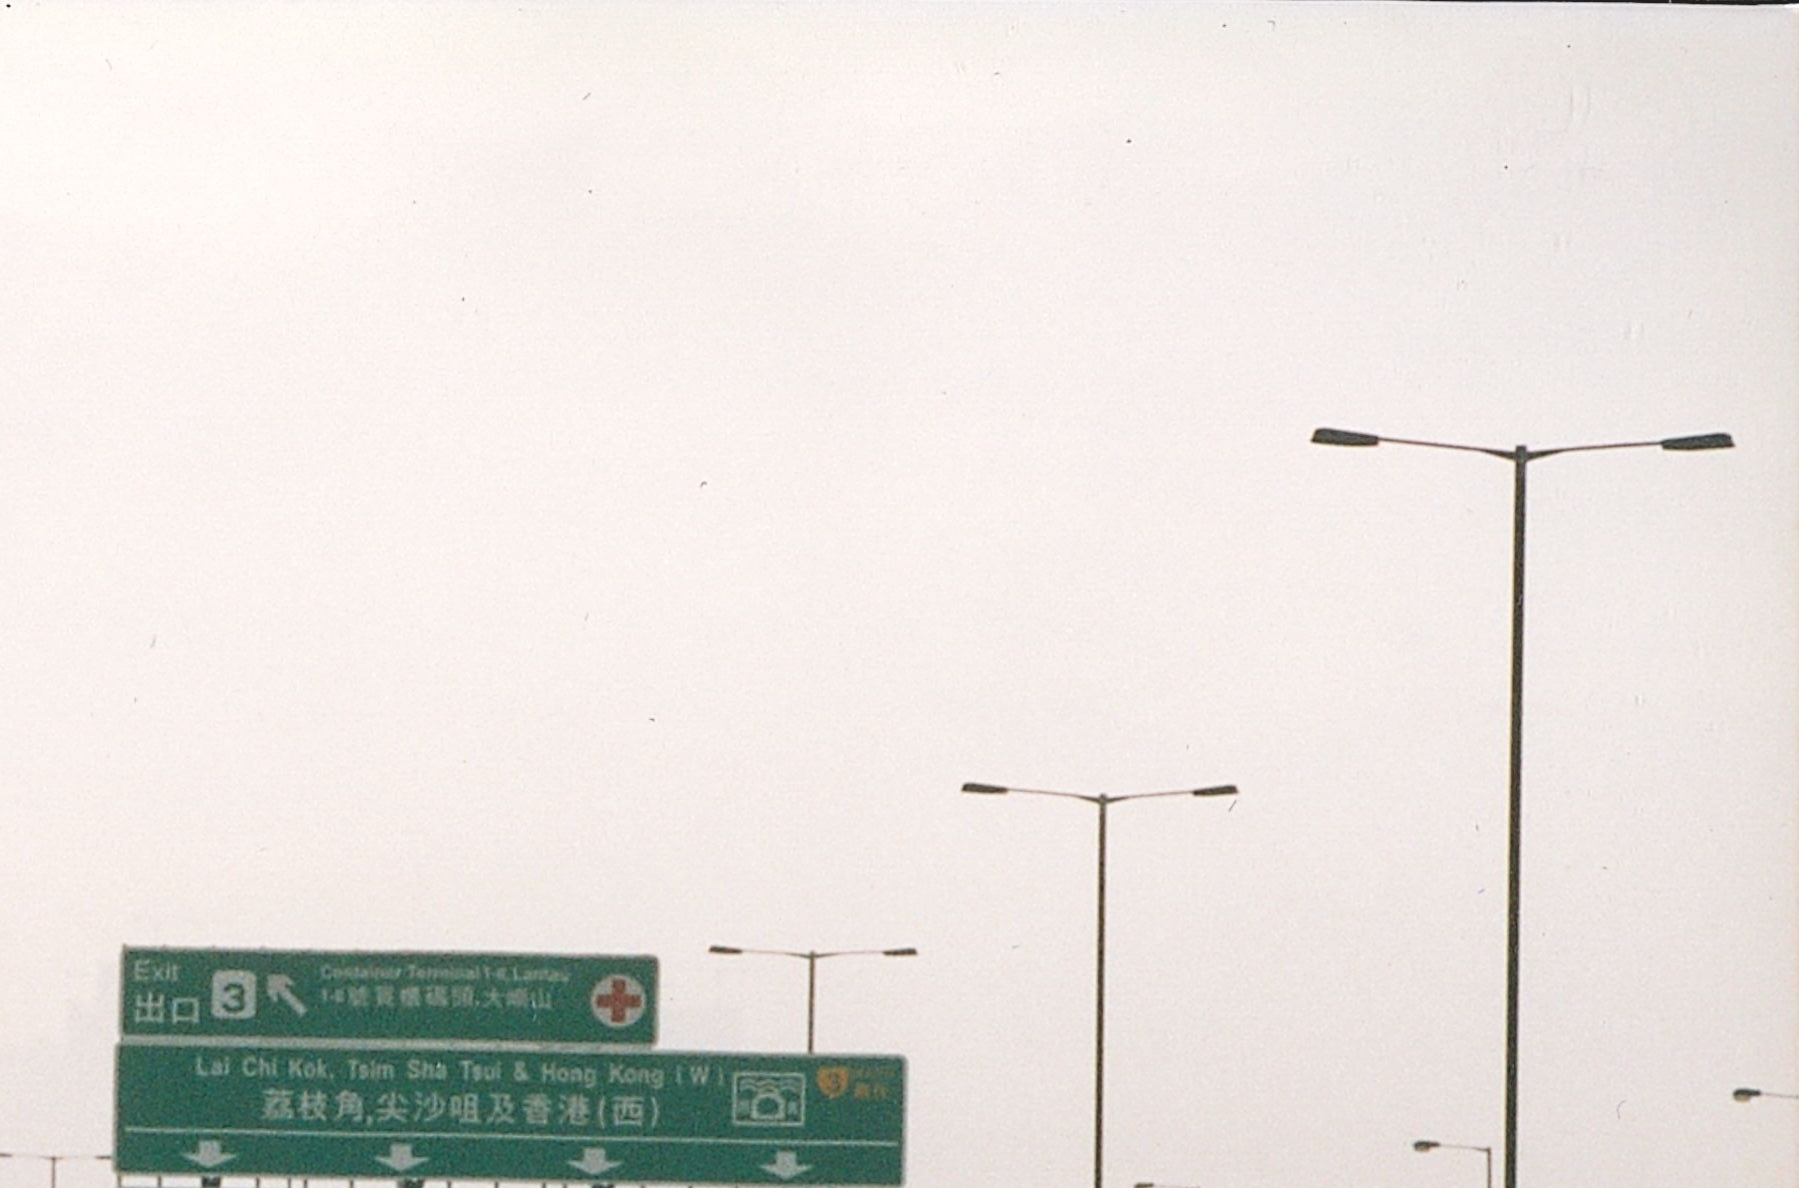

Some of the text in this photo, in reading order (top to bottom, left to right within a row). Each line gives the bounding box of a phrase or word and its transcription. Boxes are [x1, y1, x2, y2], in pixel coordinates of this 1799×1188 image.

[134, 959, 180, 982] Exit
[321, 964, 401, 981] Container
[406, 964, 481, 981] Terminal
[135, 991, 201, 1023] 出口
[221, 982, 246, 1013] 3
[195, 1055, 230, 1077] Lai
[242, 1056, 278, 1078] Chi
[348, 1058, 395, 1081] Tsim
[407, 1059, 448, 1081] Sha
[459, 1060, 502, 1082] Tsui
[513, 1060, 530, 1082] &
[541, 1062, 596, 1088] Hong
[609, 1063, 664, 1089] Kong
